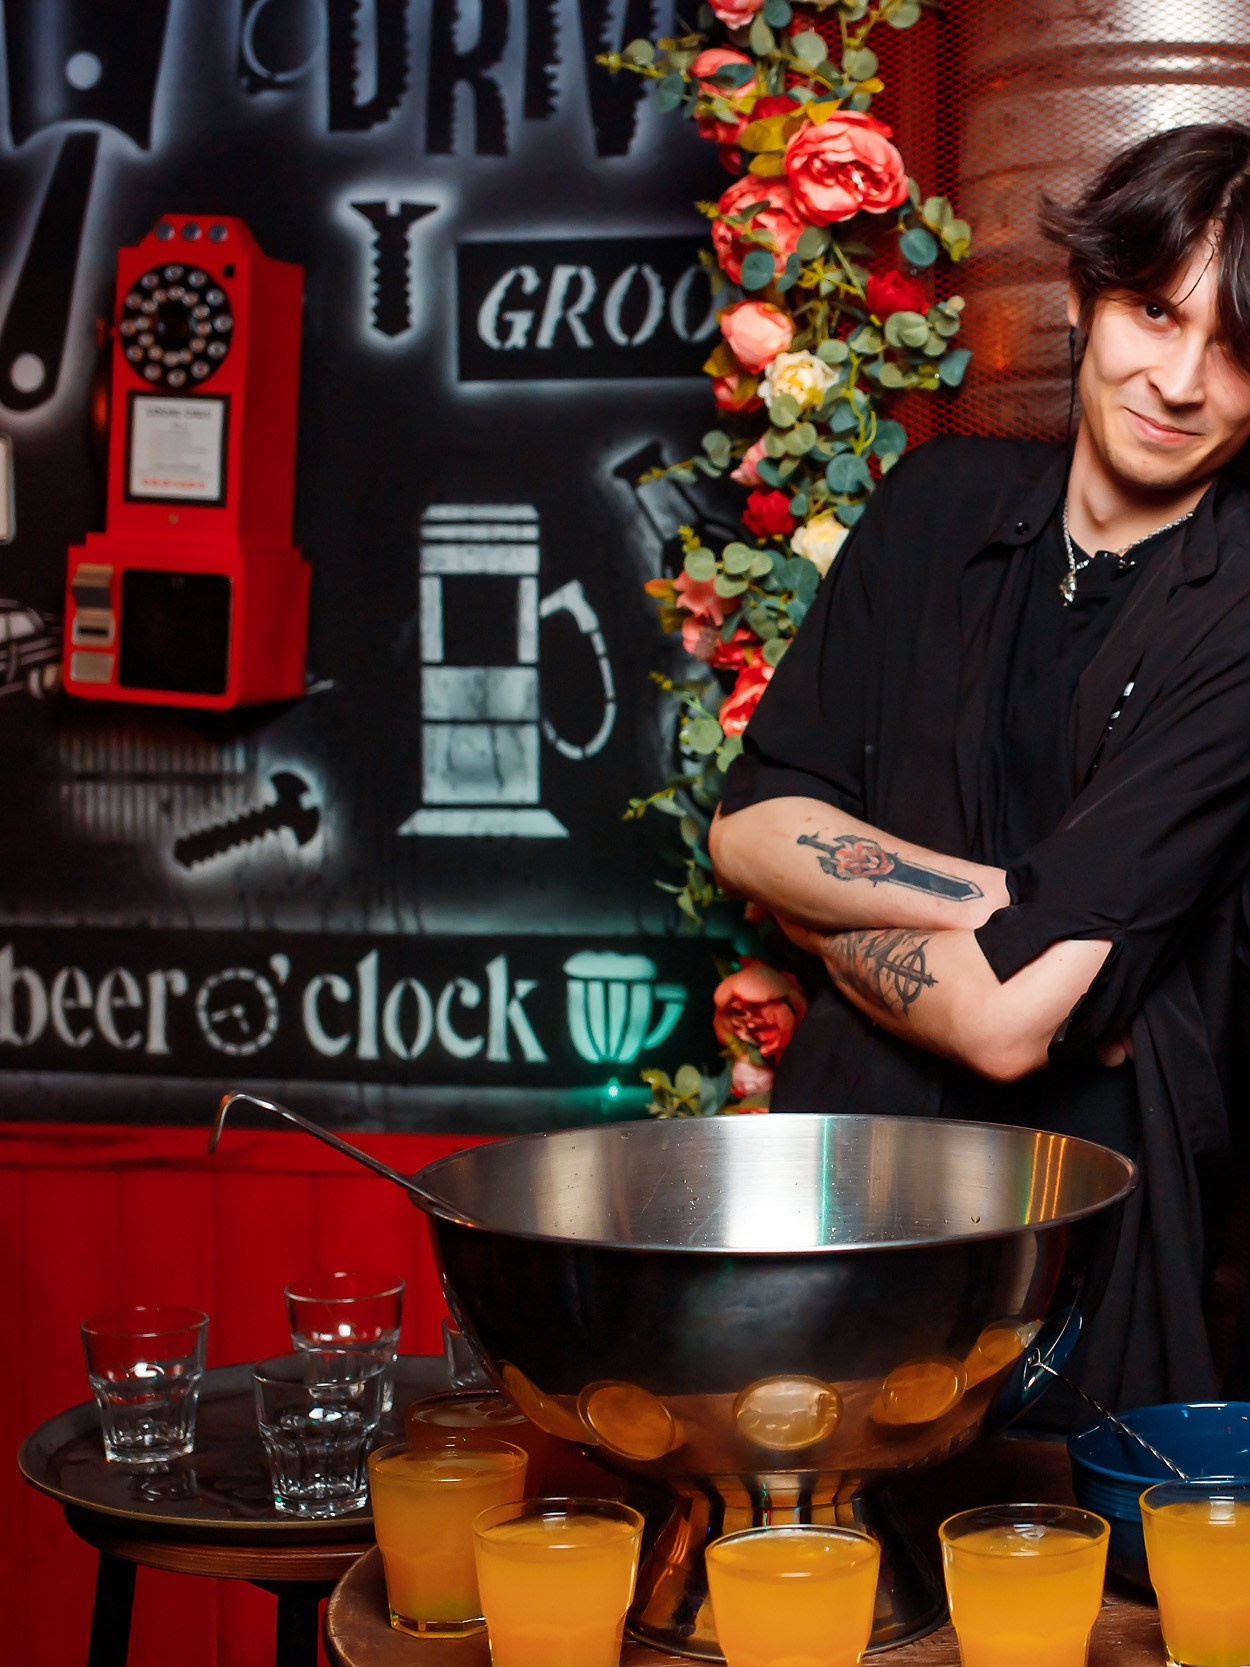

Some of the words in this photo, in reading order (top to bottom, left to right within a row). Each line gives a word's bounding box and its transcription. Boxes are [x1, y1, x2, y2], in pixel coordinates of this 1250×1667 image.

[328, 0, 694, 157] DRIV
[477, 263, 740, 350] GROO
[0, 943, 188, 1055] beer
